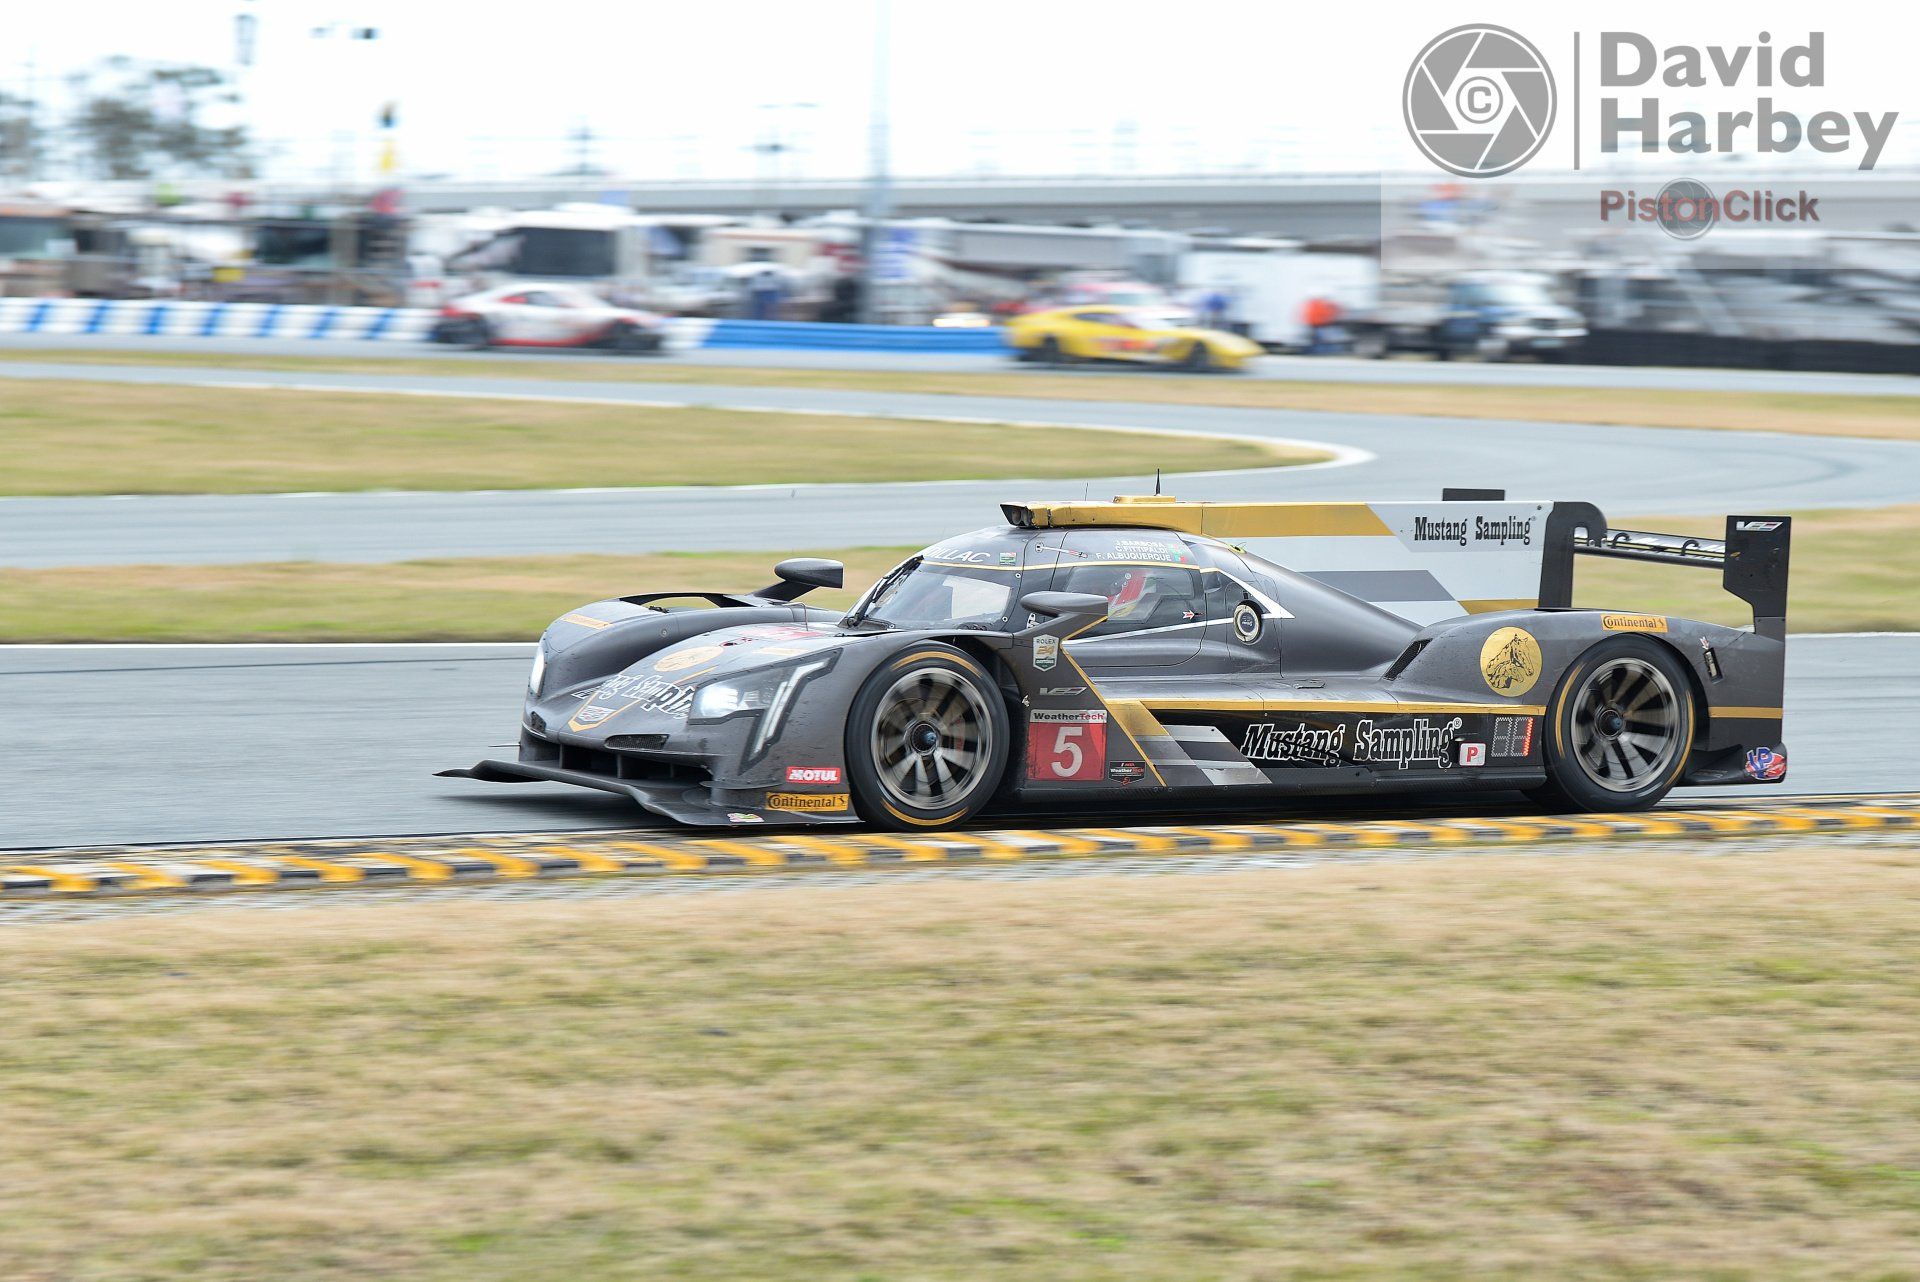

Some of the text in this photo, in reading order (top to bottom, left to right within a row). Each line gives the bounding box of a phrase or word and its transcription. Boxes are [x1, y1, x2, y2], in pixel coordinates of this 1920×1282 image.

[1414, 516, 1468, 547] Mustang
[1603, 615, 1658, 630] Continental
[1033, 712, 1105, 721] WeatherTech
[1051, 726, 1083, 777] 5
[1241, 723, 1346, 767] Mustang
[1466, 746, 1479, 762] P
[789, 769, 839, 781] MOTUL
[768, 794, 836, 809] Continental
